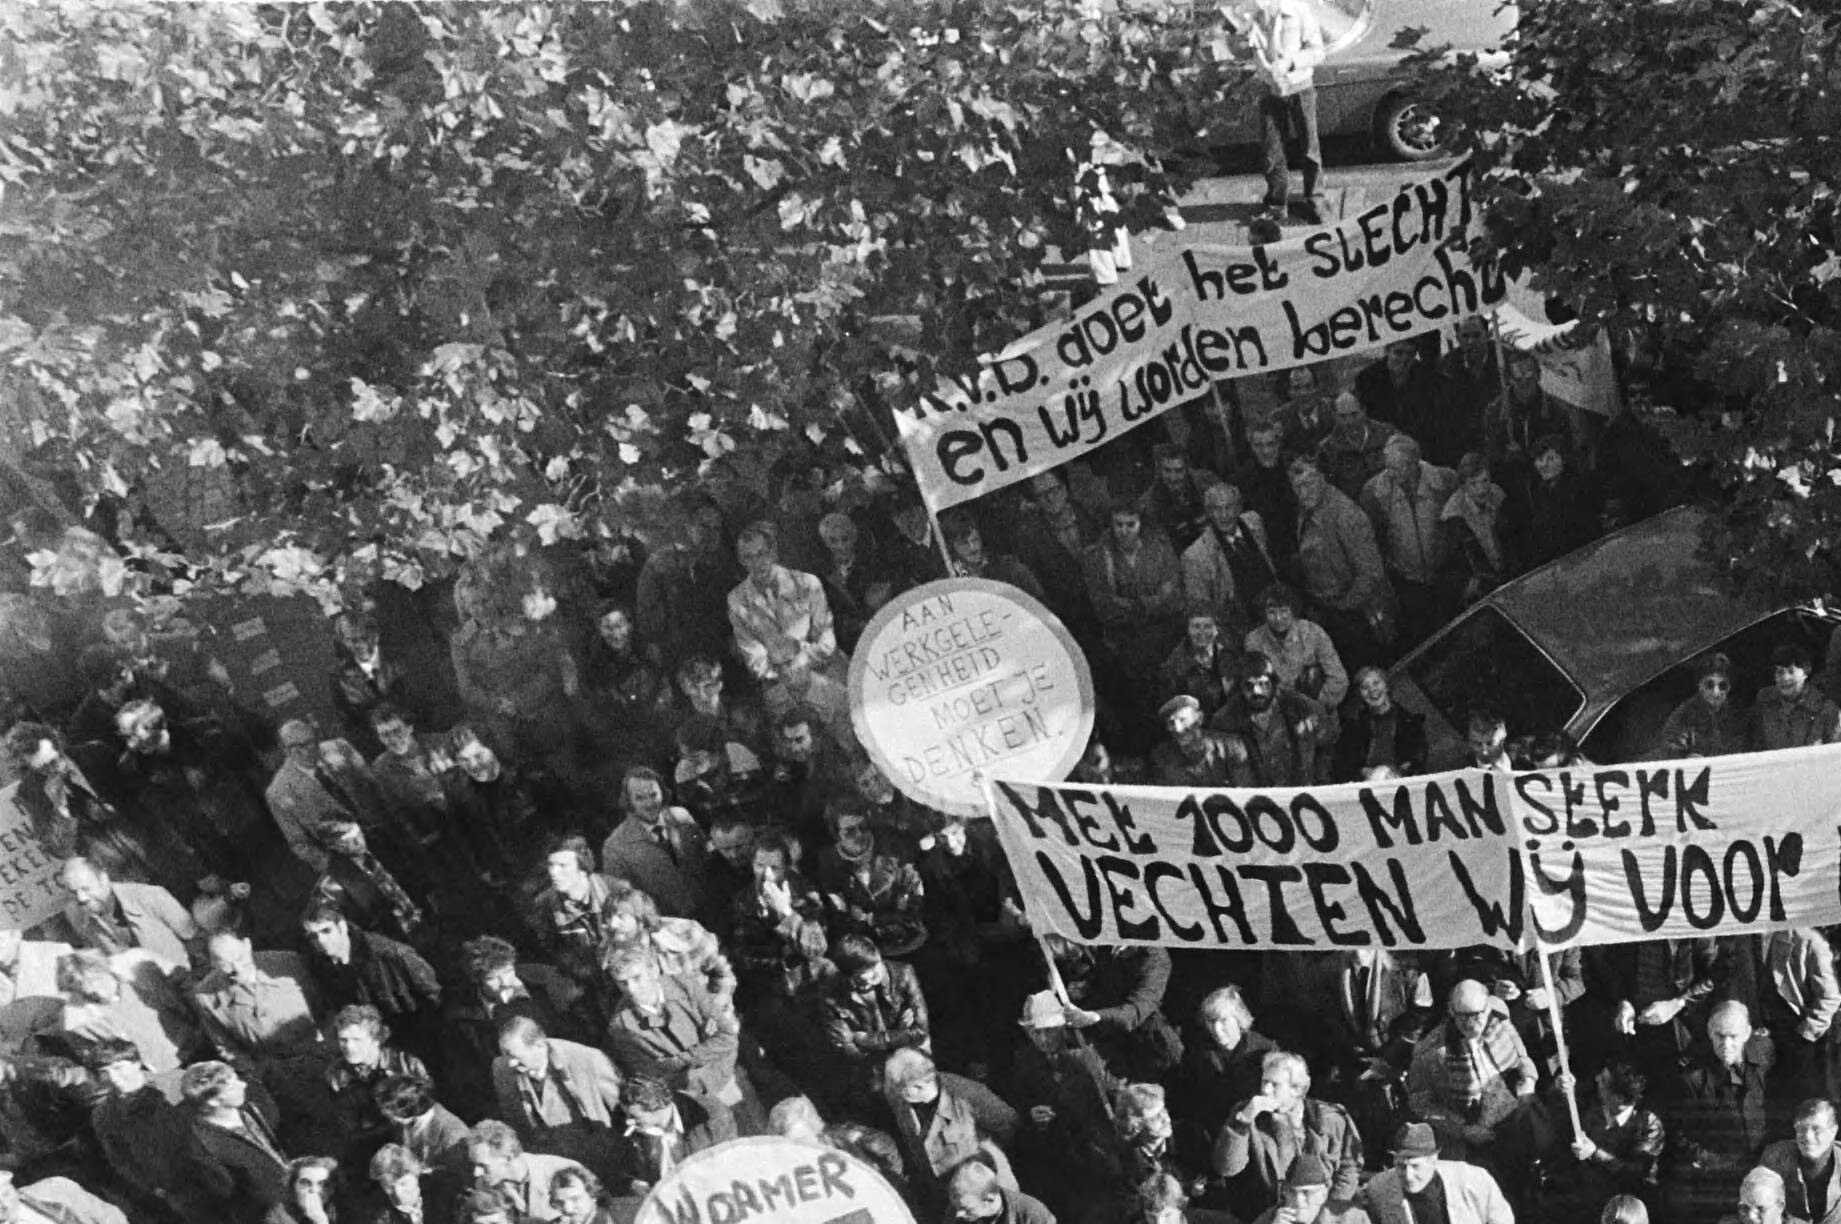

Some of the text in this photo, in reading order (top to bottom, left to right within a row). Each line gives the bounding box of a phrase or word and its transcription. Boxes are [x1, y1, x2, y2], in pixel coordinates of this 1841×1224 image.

[1183, 246, 1289, 300] het
[1305, 158, 1474, 278] SLECHT
[936, 417, 1029, 486] en
[1119, 323, 1268, 422] worden
[902, 595, 955, 632] AAN
[888, 647, 1001, 706] GENHEID
[931, 664, 1054, 730] MOET JE
[1175, 792, 1339, 857] 1000
[1358, 773, 1507, 849] MAN
[1035, 849, 1426, 946] VECHTEN
